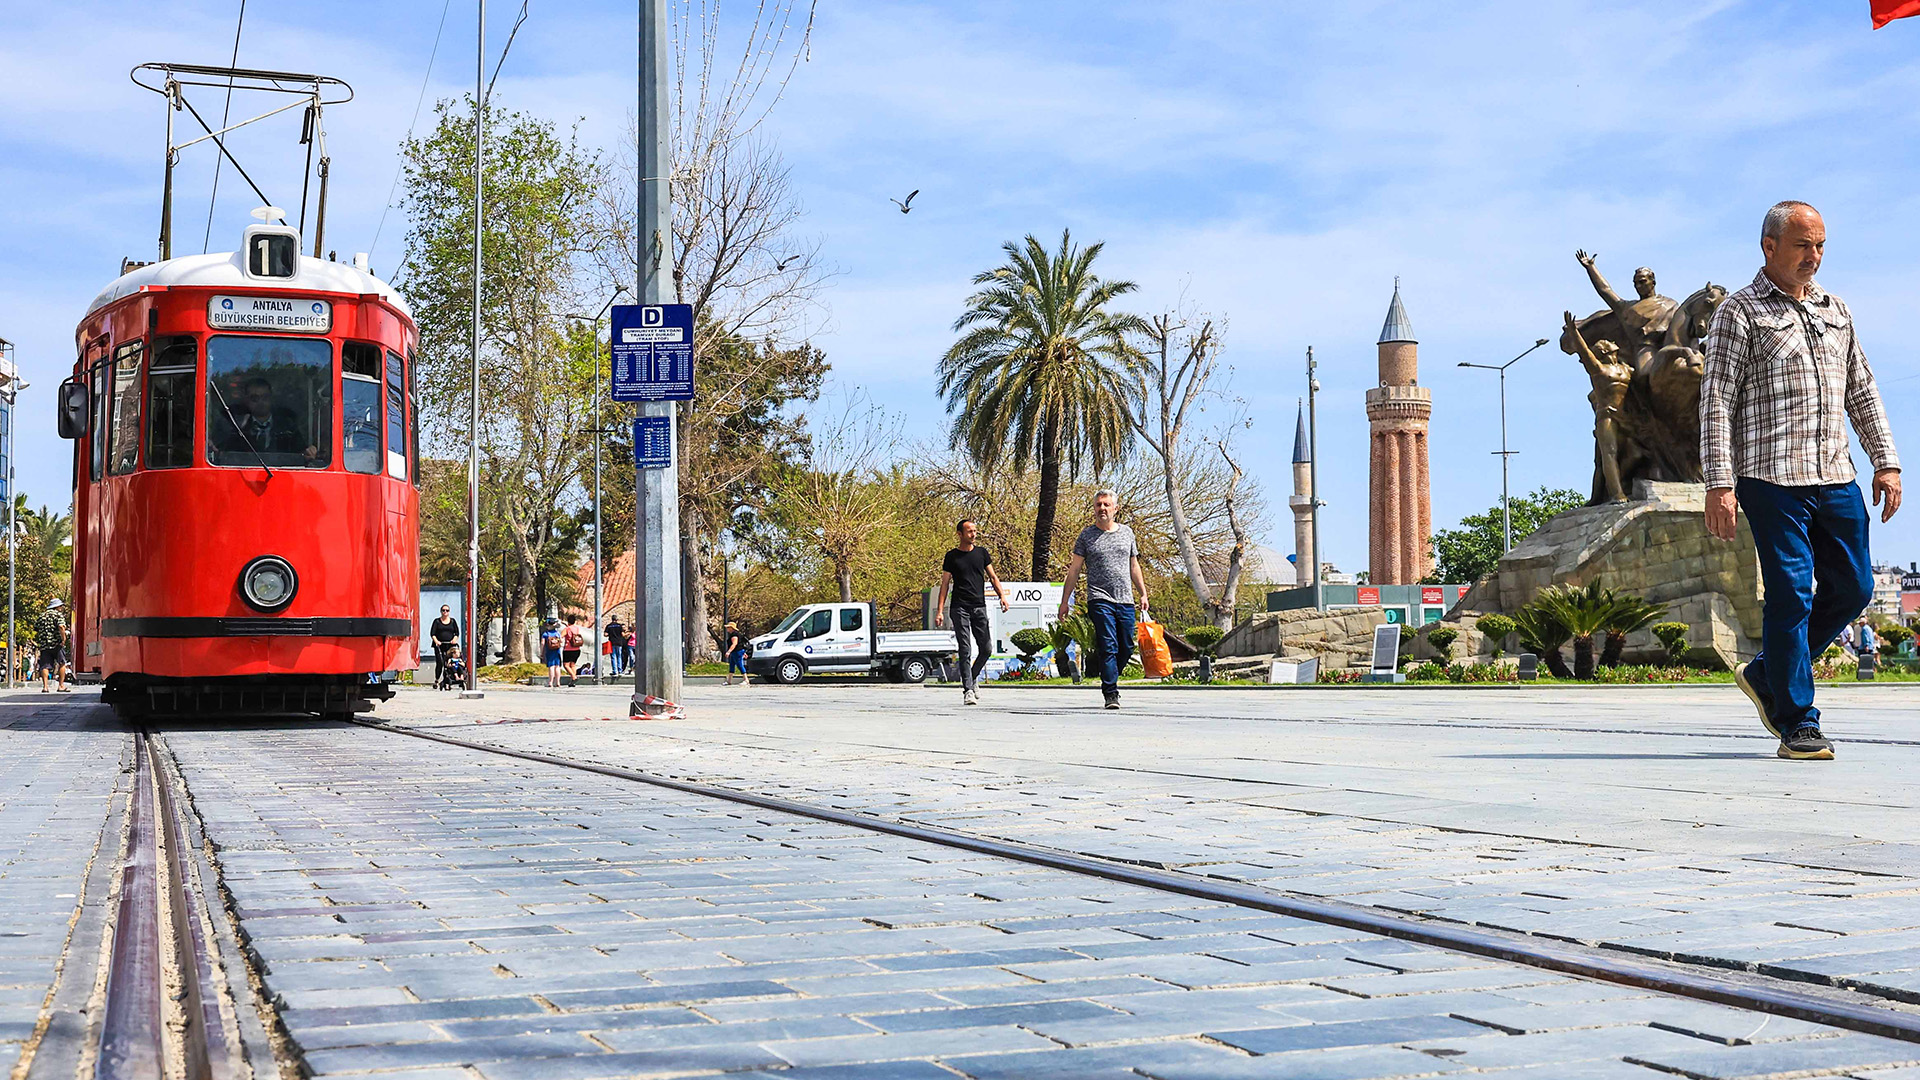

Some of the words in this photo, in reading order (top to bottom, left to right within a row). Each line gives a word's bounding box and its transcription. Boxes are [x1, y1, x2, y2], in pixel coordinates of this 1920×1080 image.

[257, 239, 270, 275] 1
[252, 300, 293, 311] ANTALYA
[214, 311, 275, 327] BÜYÜKŞEHİR
[644, 308, 660, 325] D
[1015, 589, 1042, 601] ARO
